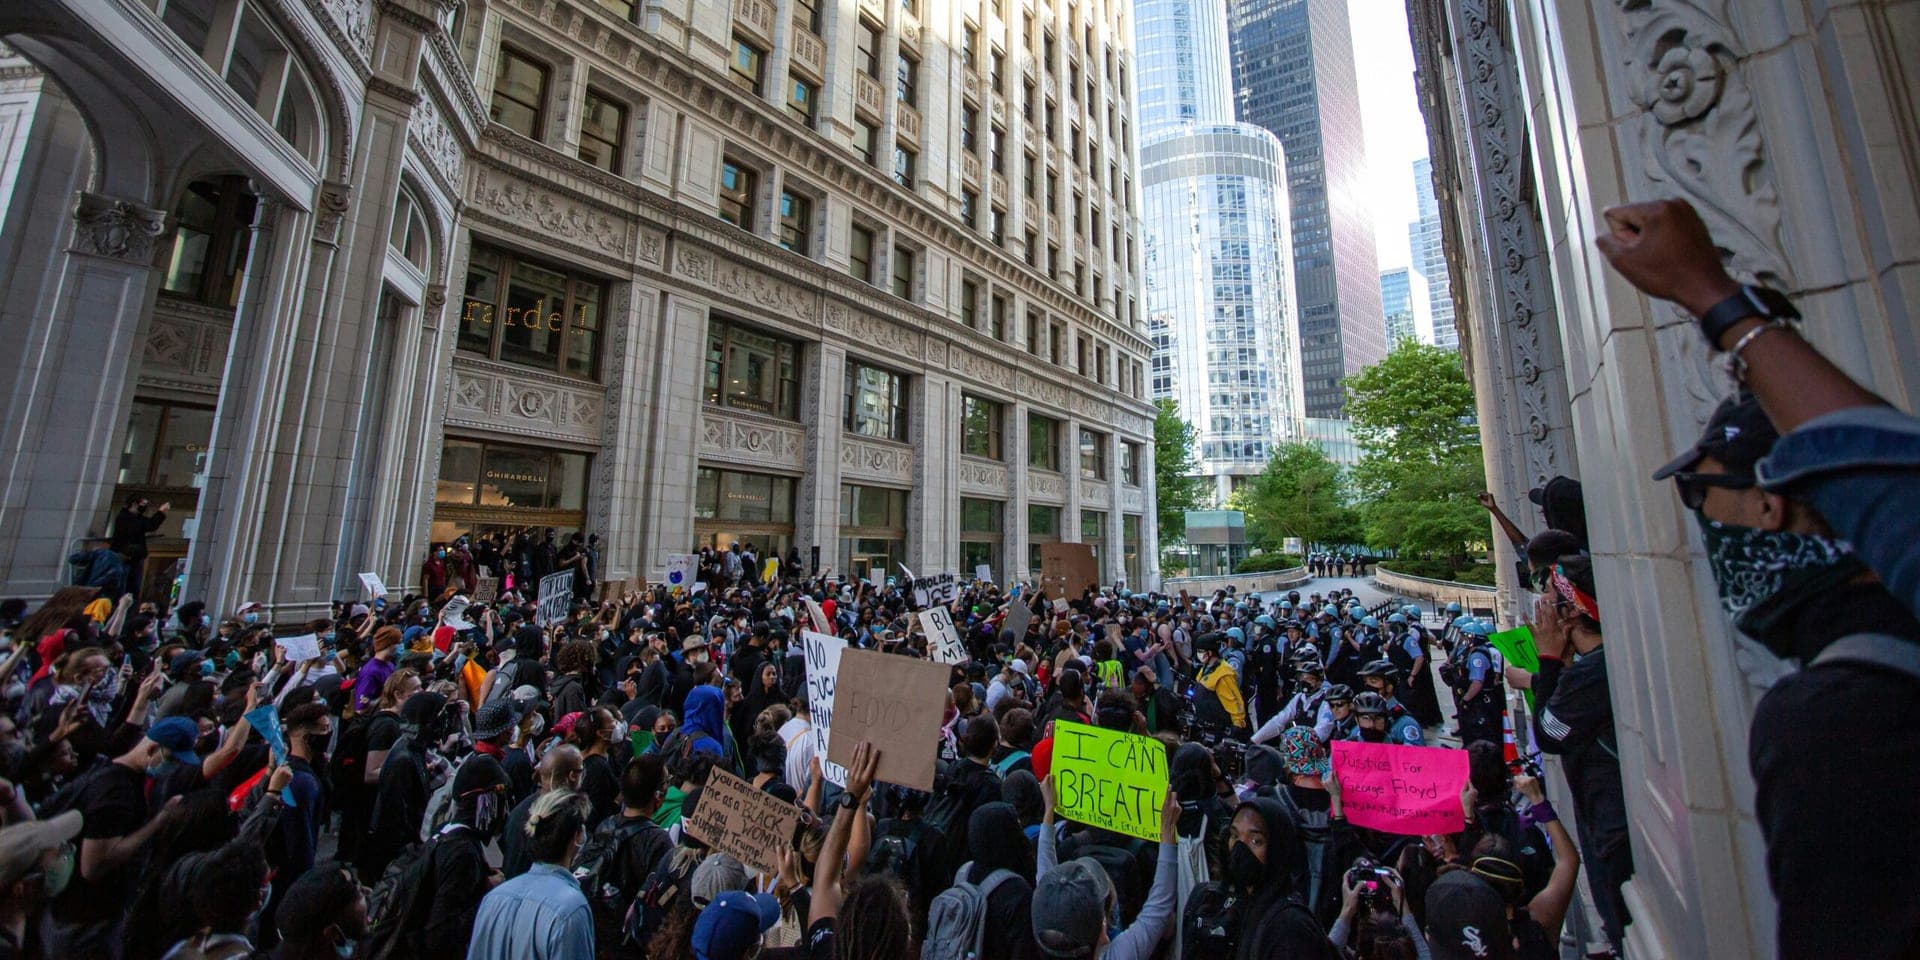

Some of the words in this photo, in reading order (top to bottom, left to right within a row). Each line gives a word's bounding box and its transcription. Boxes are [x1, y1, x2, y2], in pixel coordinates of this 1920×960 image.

[486, 471, 546, 483] GHIRARDELLI
[913, 573, 954, 590] ABOLISH
[918, 584, 953, 609] ICE
[806, 637, 826, 671] NO
[816, 727, 827, 752] A
[733, 781, 763, 801] cannot
[763, 796, 798, 819] support
[1391, 778, 1437, 799] Floyd
[704, 785, 721, 801] me
[723, 795, 733, 808] as
[733, 800, 740, 811] a
[741, 800, 784, 836] BLACK
[709, 807, 728, 826] you
[1462, 926, 1488, 957] Sox
